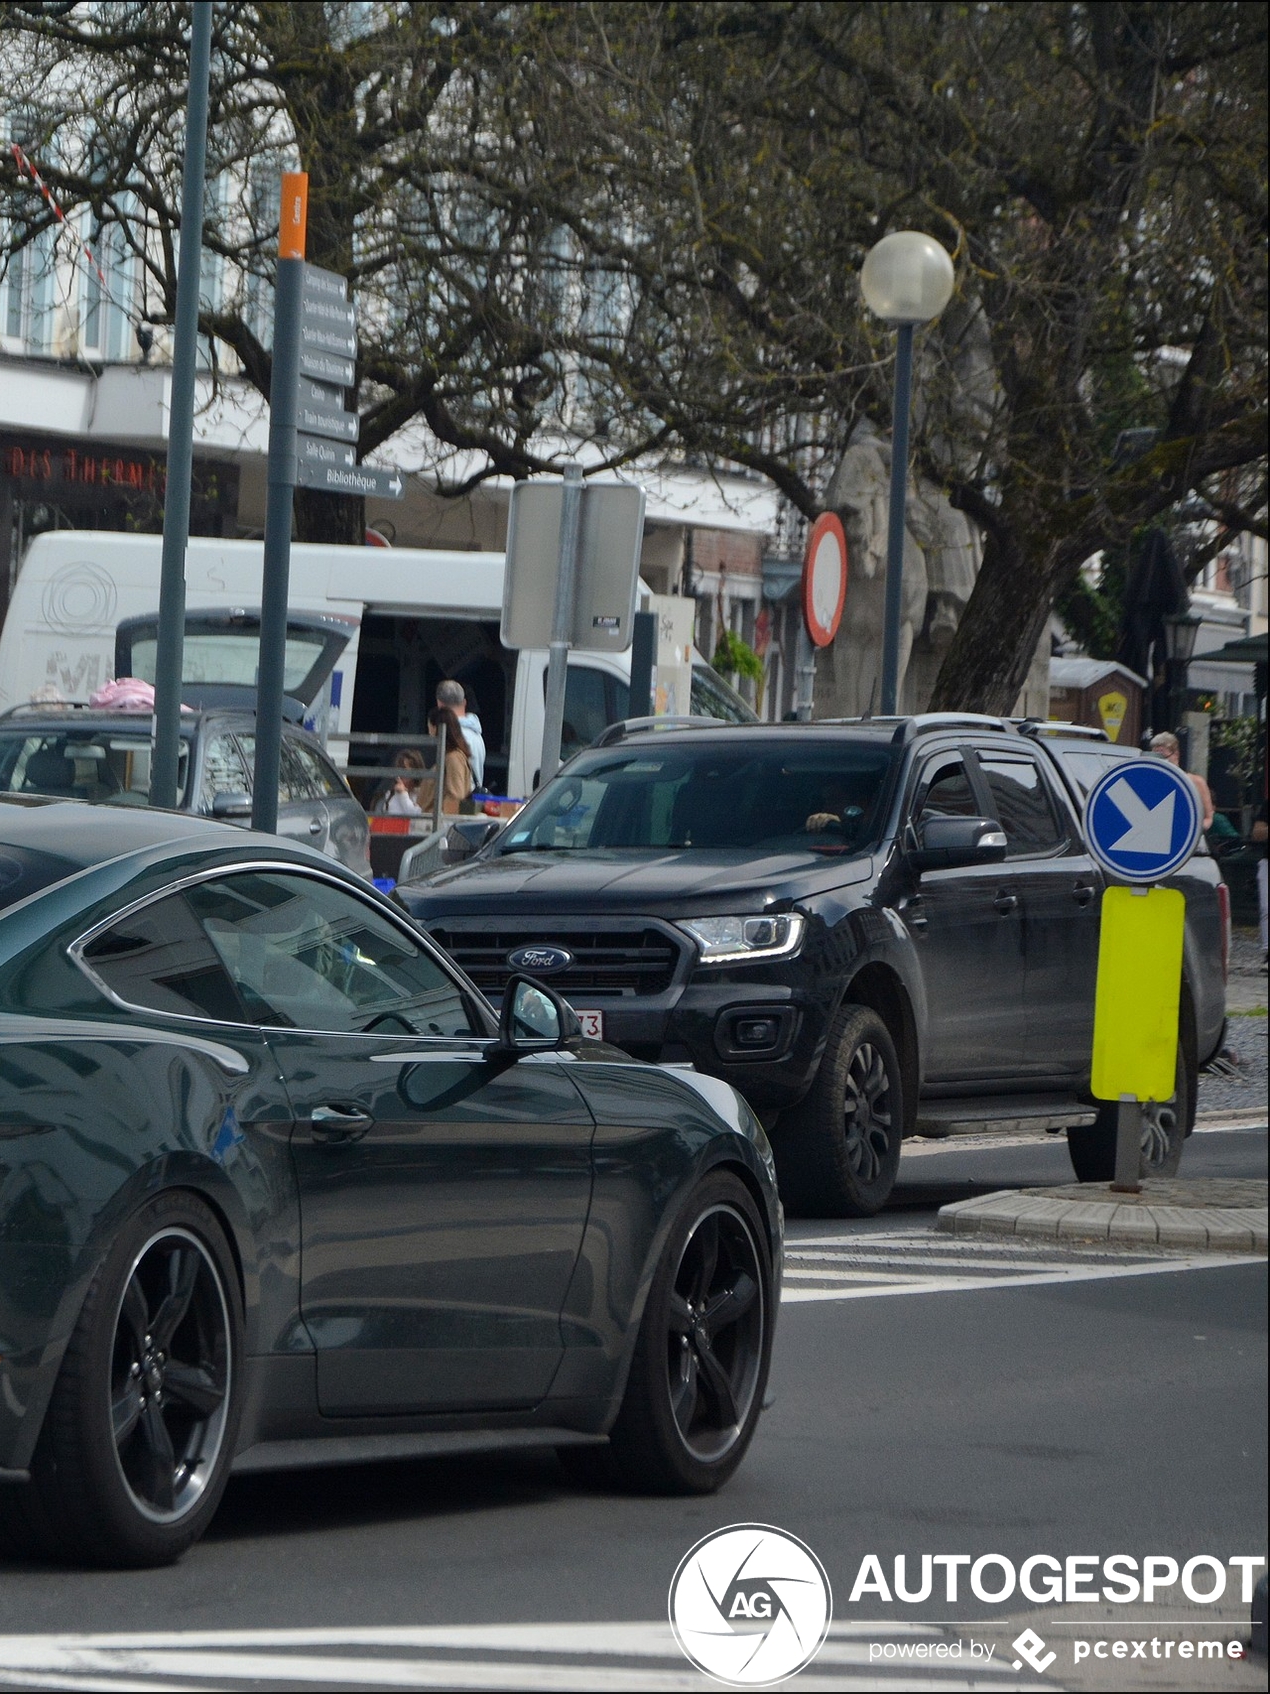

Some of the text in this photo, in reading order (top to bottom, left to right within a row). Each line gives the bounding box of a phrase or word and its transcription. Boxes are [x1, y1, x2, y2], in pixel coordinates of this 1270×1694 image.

[10, 446, 51, 480] DES
[65, 448, 168, 493] THERME
[326, 468, 377, 491] Bibliothèque
[521, 950, 555, 966] Ford
